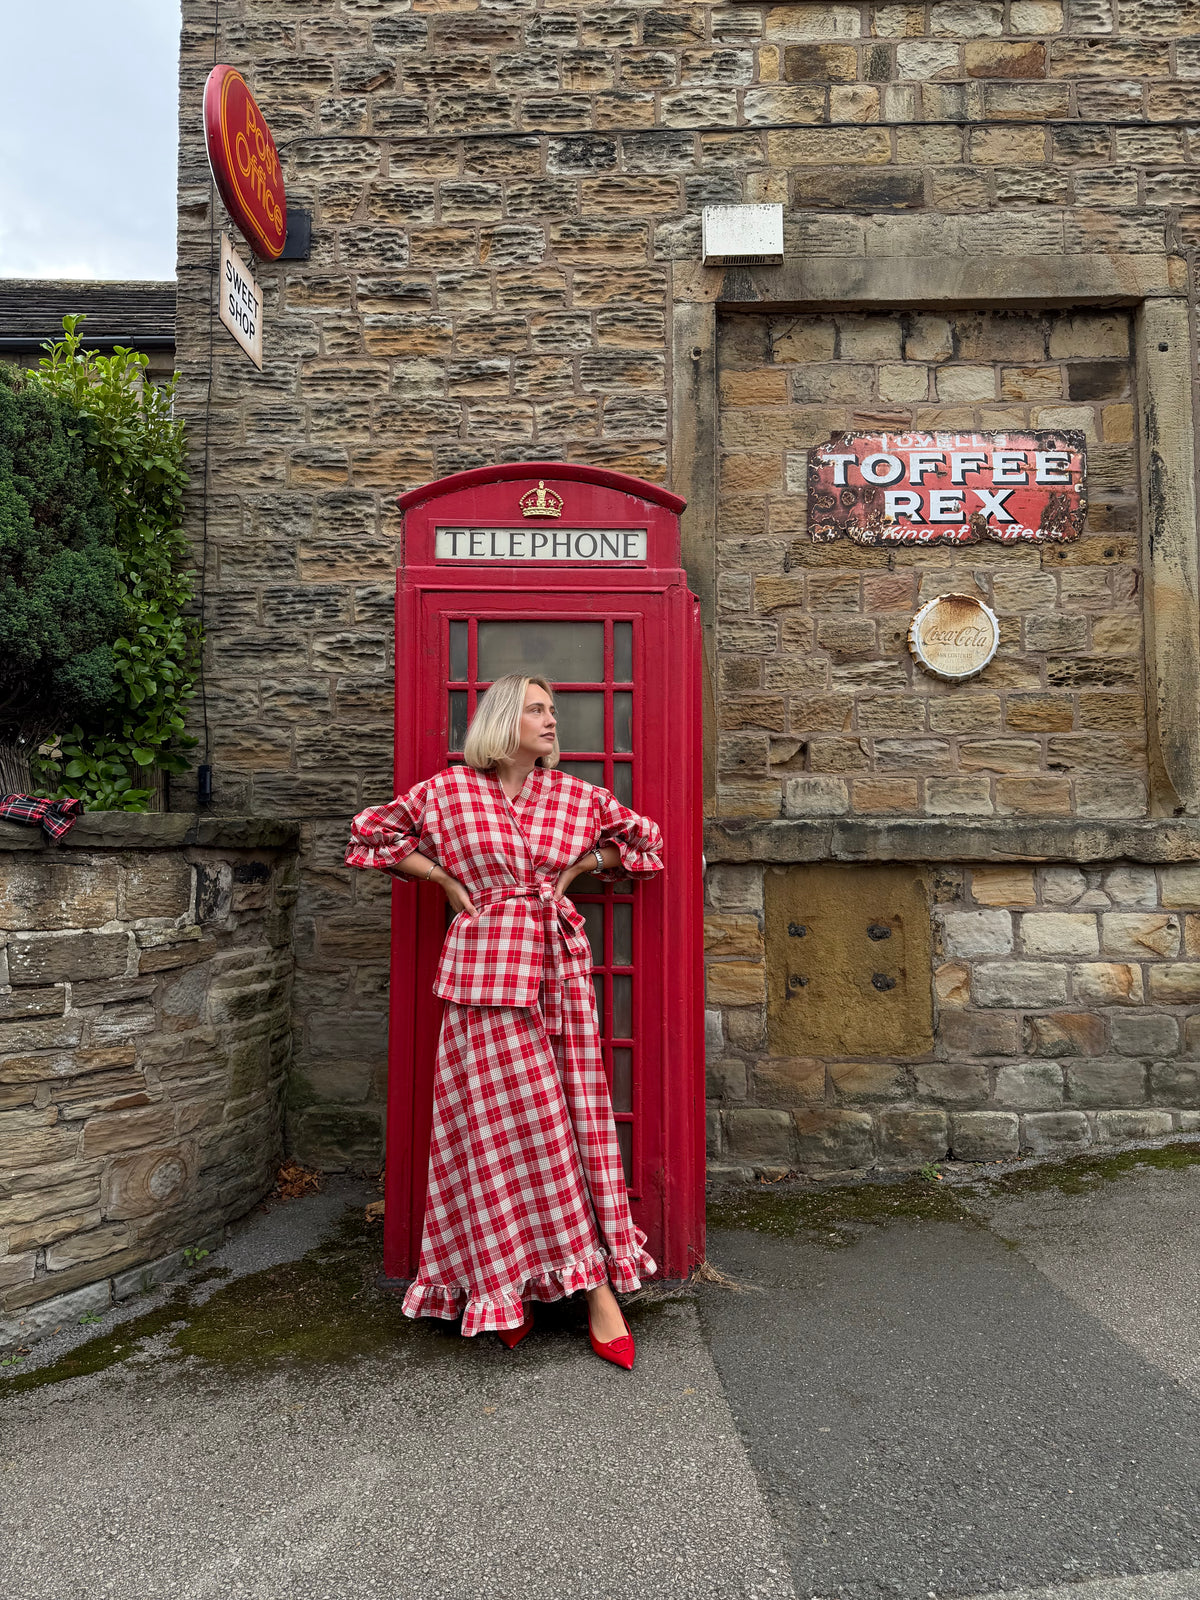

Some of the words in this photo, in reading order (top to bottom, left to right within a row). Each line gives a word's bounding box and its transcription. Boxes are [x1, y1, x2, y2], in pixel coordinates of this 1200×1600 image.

[245, 97, 278, 187] Post
[236, 132, 283, 236] Office
[225, 259, 259, 319] SWEET
[228, 296, 256, 340] SHOP
[882, 433, 1007, 451] LOVELLS
[821, 451, 1073, 486] TOFFEE
[883, 489, 1020, 524] REX
[445, 531, 640, 558] TELEPHONE
[881, 526, 934, 543] King
[942, 524, 970, 539] of
[984, 524, 1063, 539] offees
[922, 625, 989, 647] Coca-Cola
